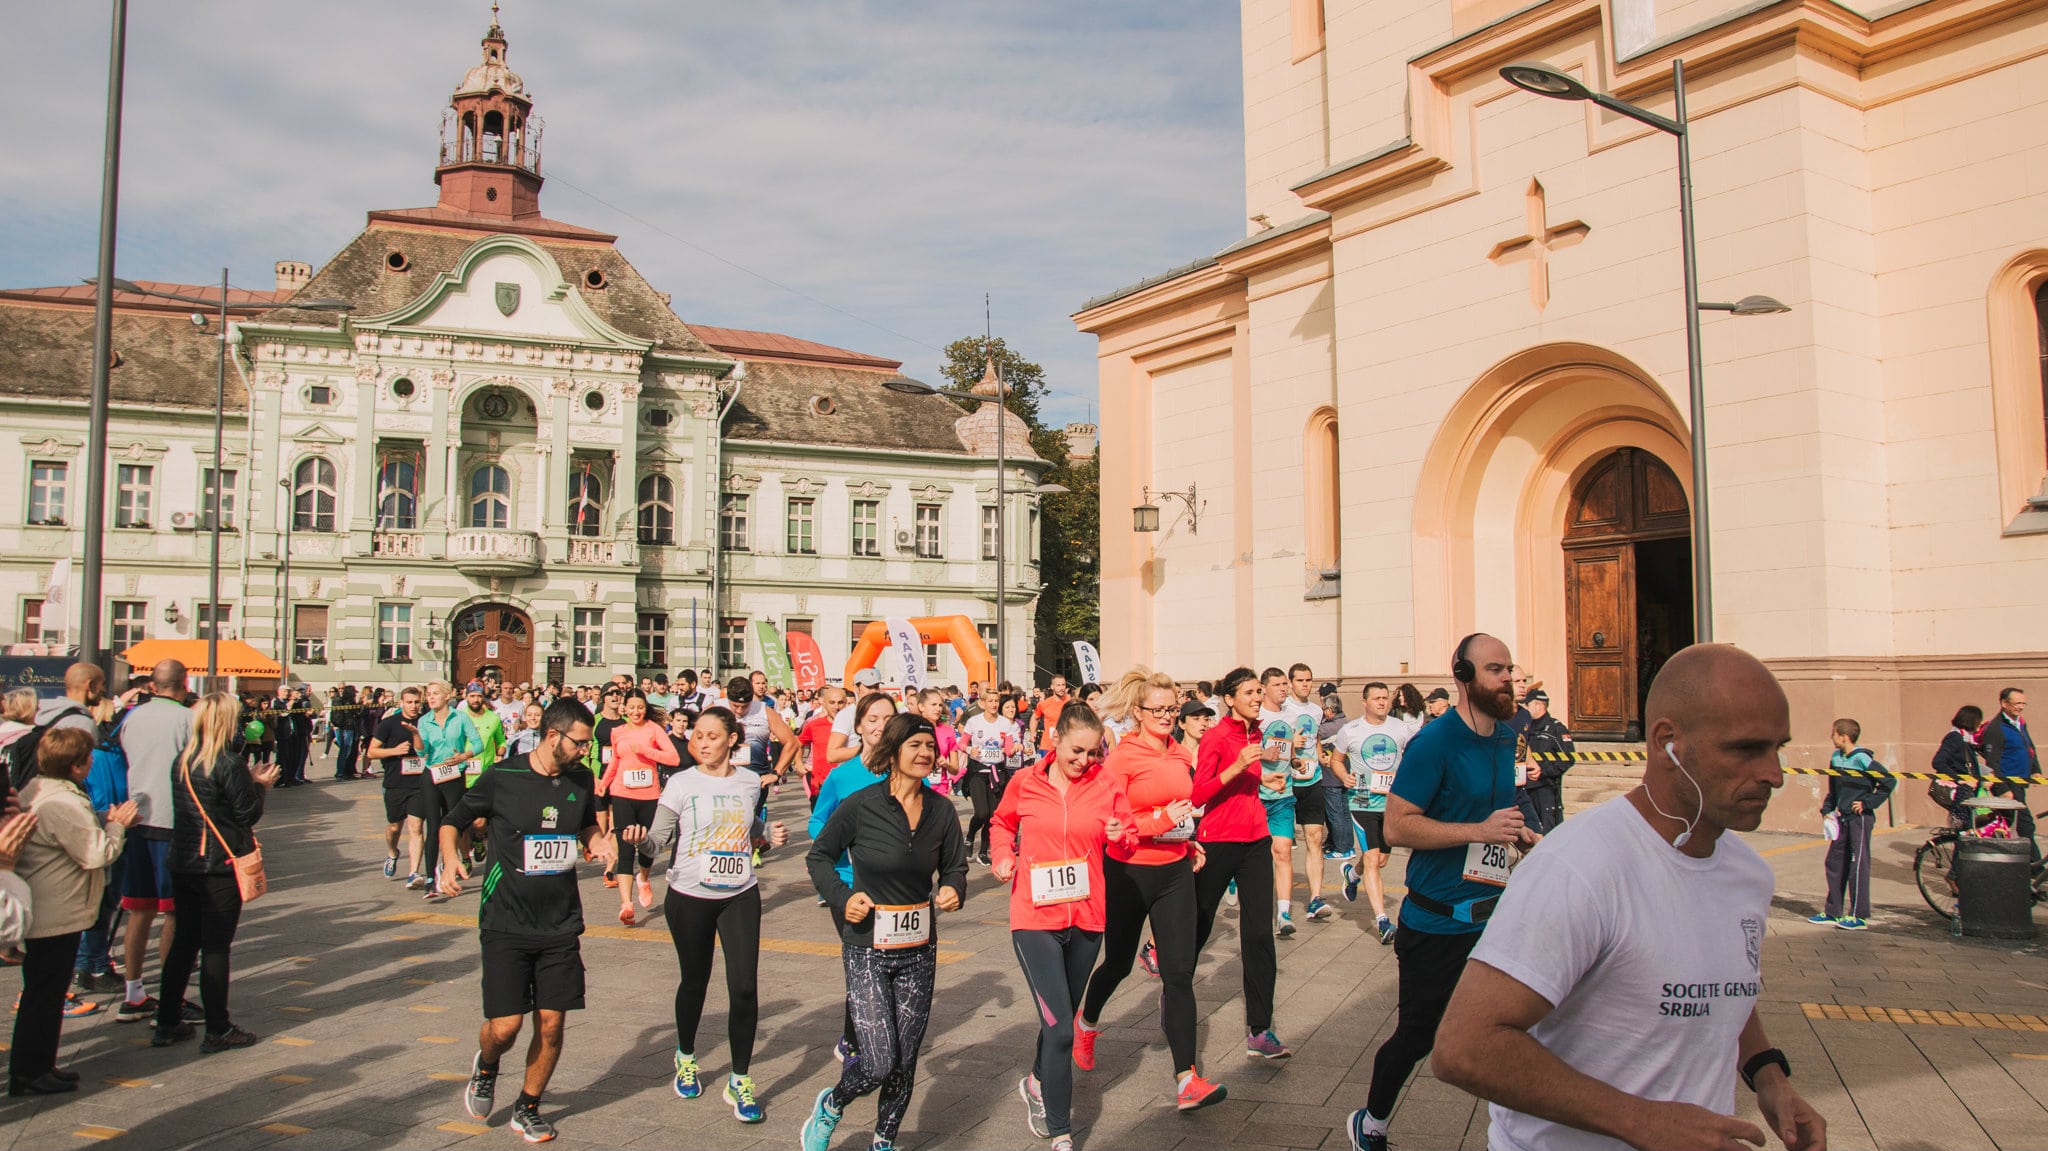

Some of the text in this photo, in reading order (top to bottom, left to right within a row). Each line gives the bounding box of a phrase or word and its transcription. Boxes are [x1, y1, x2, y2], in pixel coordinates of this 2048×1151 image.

[223, 667, 281, 675] capriolo
[438, 764, 453, 776] 109
[631, 770, 646, 781] 115
[1380, 775, 1393, 786] 112
[712, 794, 744, 809] IT'S
[711, 809, 746, 825] FINE
[714, 823, 749, 839] RUN
[534, 841, 569, 860] 2077
[1481, 844, 1506, 869] 258
[709, 856, 744, 875] 2006
[1047, 866, 1076, 888] 116
[892, 910, 920, 932] 146
[1661, 983, 1721, 999] SOCIETE
[1658, 1001, 1710, 1017] SRBIJA
